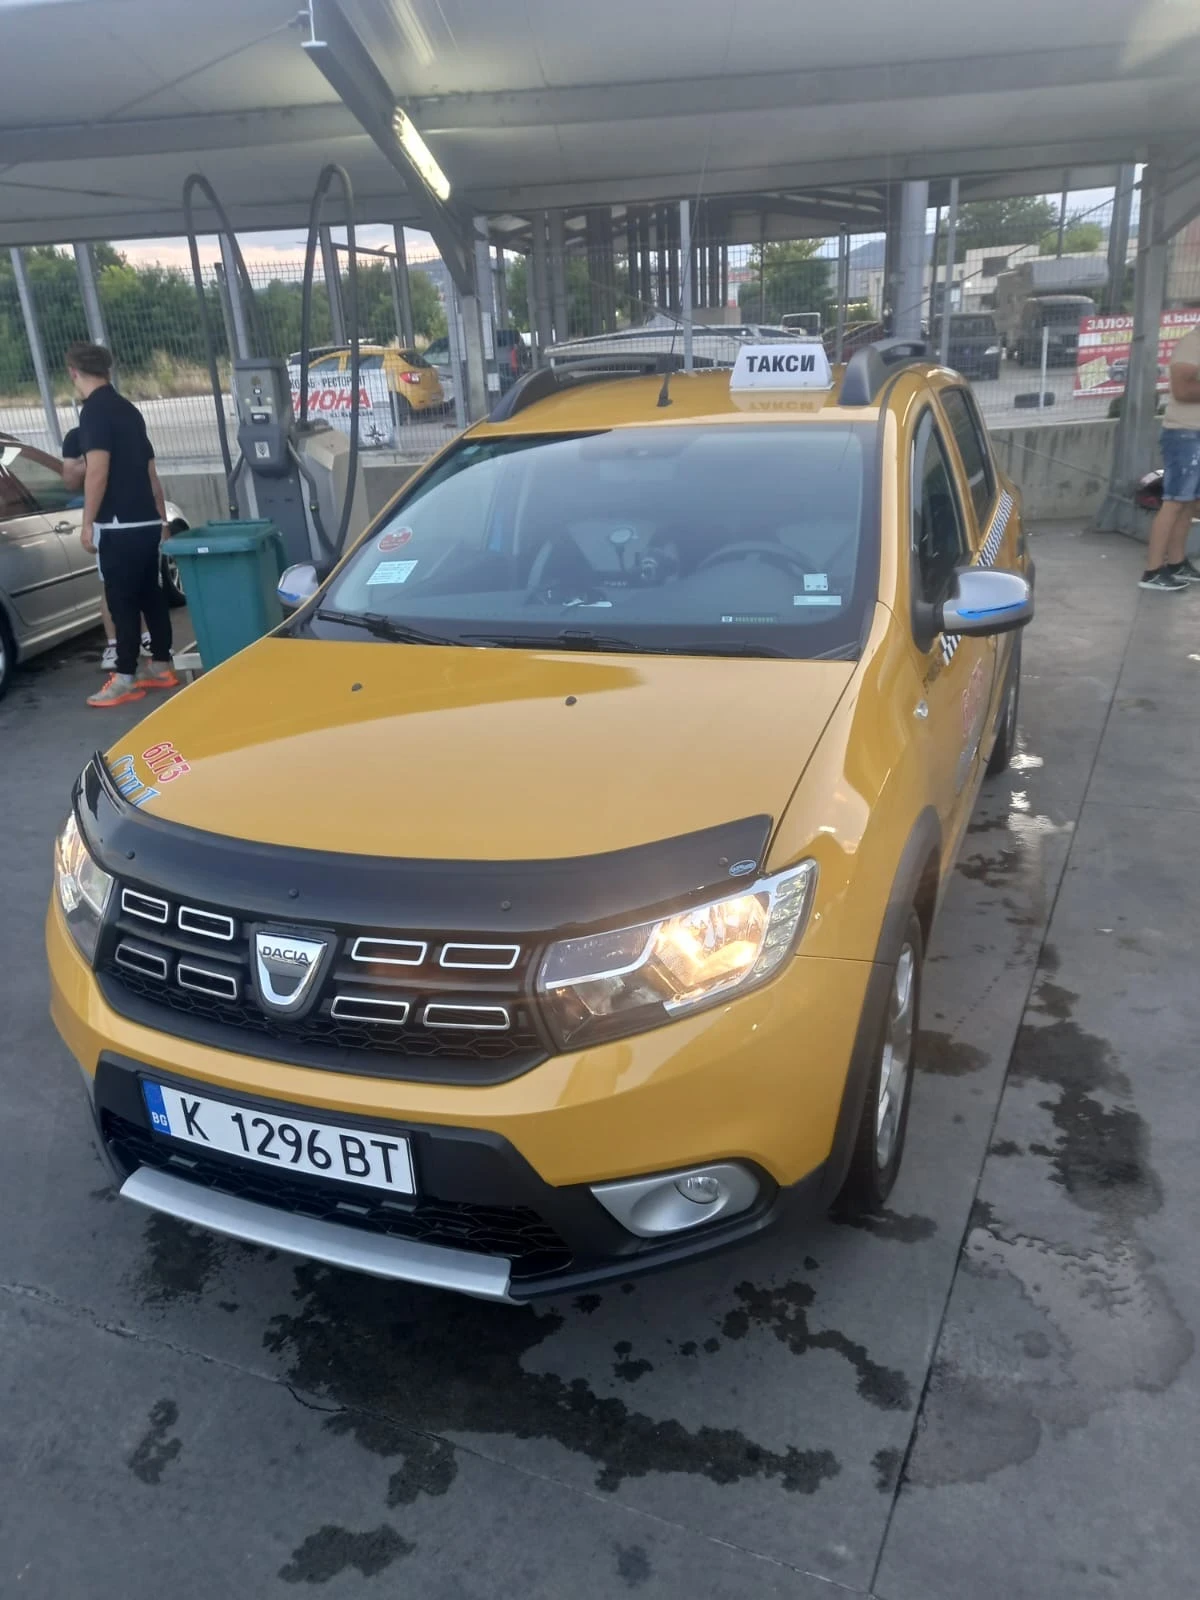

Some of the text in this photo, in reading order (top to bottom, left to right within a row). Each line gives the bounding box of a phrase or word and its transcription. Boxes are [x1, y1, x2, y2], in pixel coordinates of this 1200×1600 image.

[1086, 317, 1134, 330] ЗАЛОЖ
[746, 354, 815, 373] ТАКСИ
[322, 375, 366, 387] РЕСТОРТ
[262, 945, 309, 962] DACIA
[151, 1111, 168, 1127] BG
[180, 1097, 210, 1141] K
